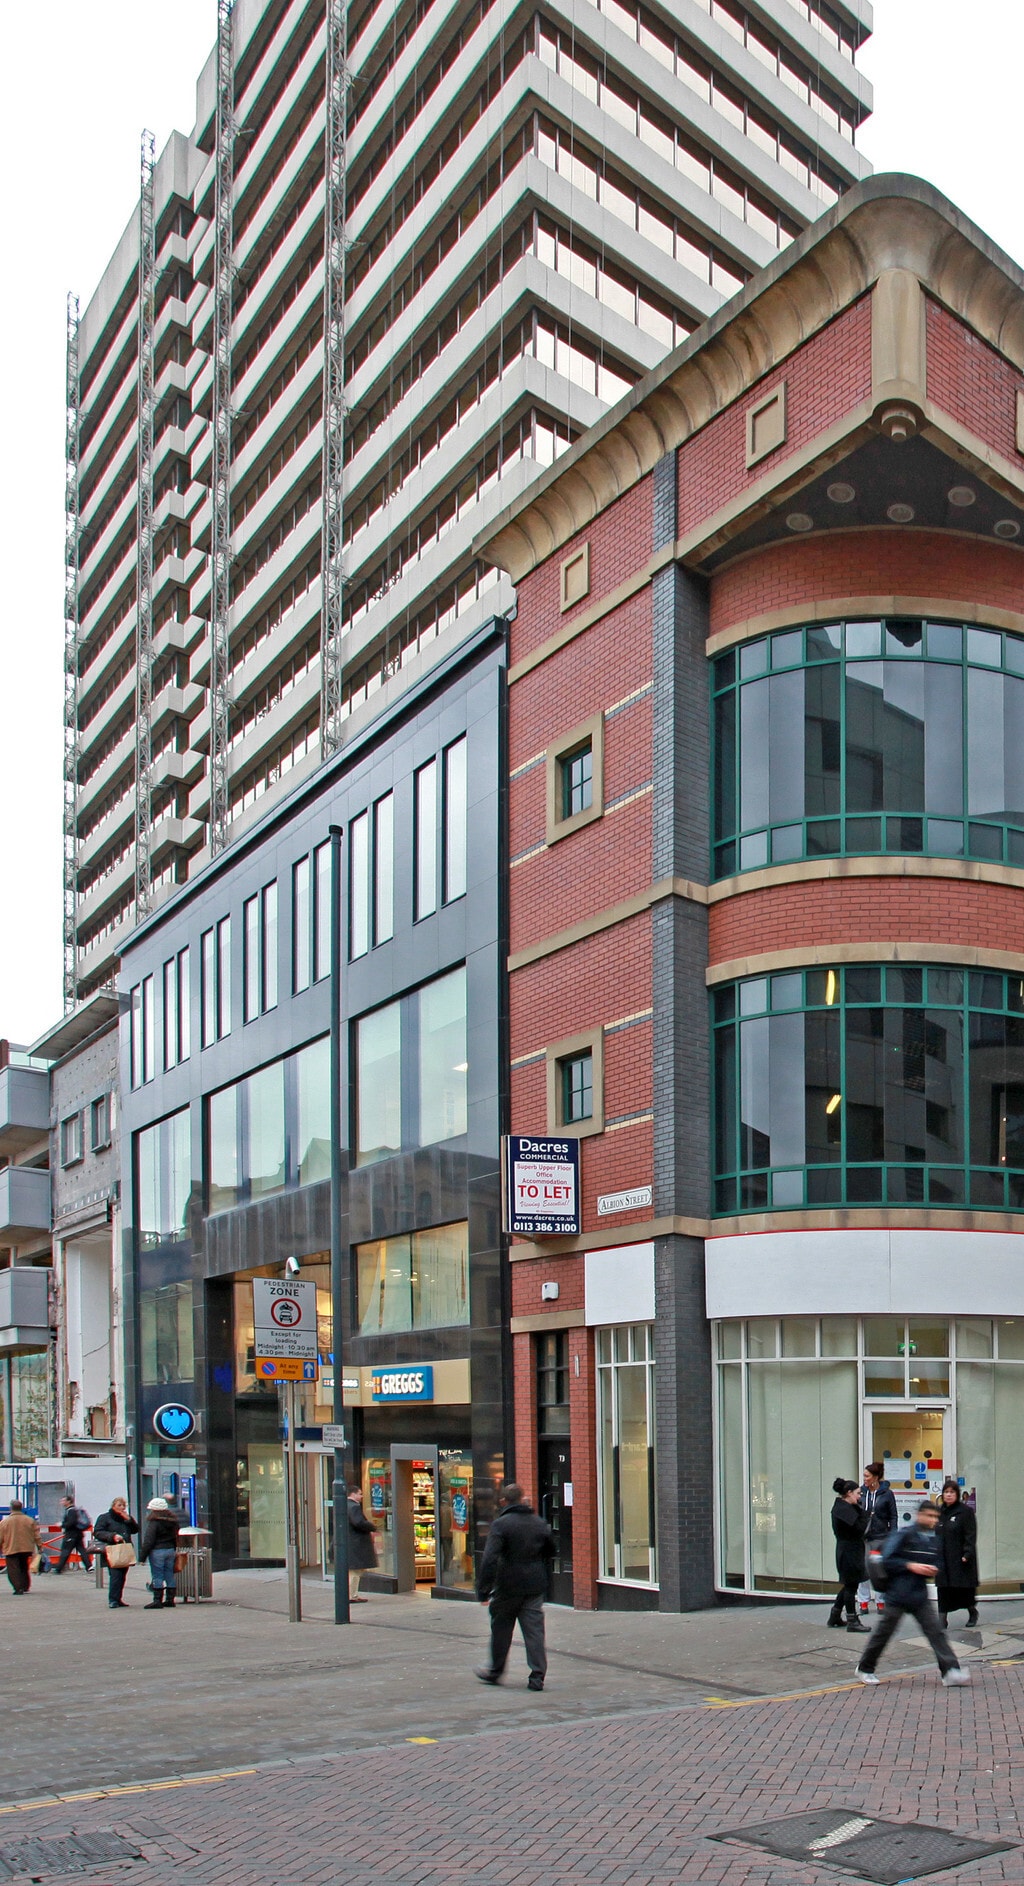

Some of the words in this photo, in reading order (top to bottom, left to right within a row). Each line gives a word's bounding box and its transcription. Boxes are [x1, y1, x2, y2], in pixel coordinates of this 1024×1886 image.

[519, 1138, 569, 1153] Dacres
[520, 1153, 568, 1161] COMMERCIAL
[517, 1185, 539, 1198] TO
[544, 1186, 572, 1199] LET
[625, 1194, 649, 1206] STREET
[515, 1214, 575, 1222] www.dacres.co.uk
[513, 1222, 534, 1231] 0113
[535, 1222, 553, 1231] 386
[554, 1223, 577, 1232] 3100
[263, 1280, 306, 1289] PEDESTRIAN
[269, 1287, 300, 1297] ZONE
[270, 1330, 292, 1338] Except
[381, 1373, 424, 1395] GREGGS
